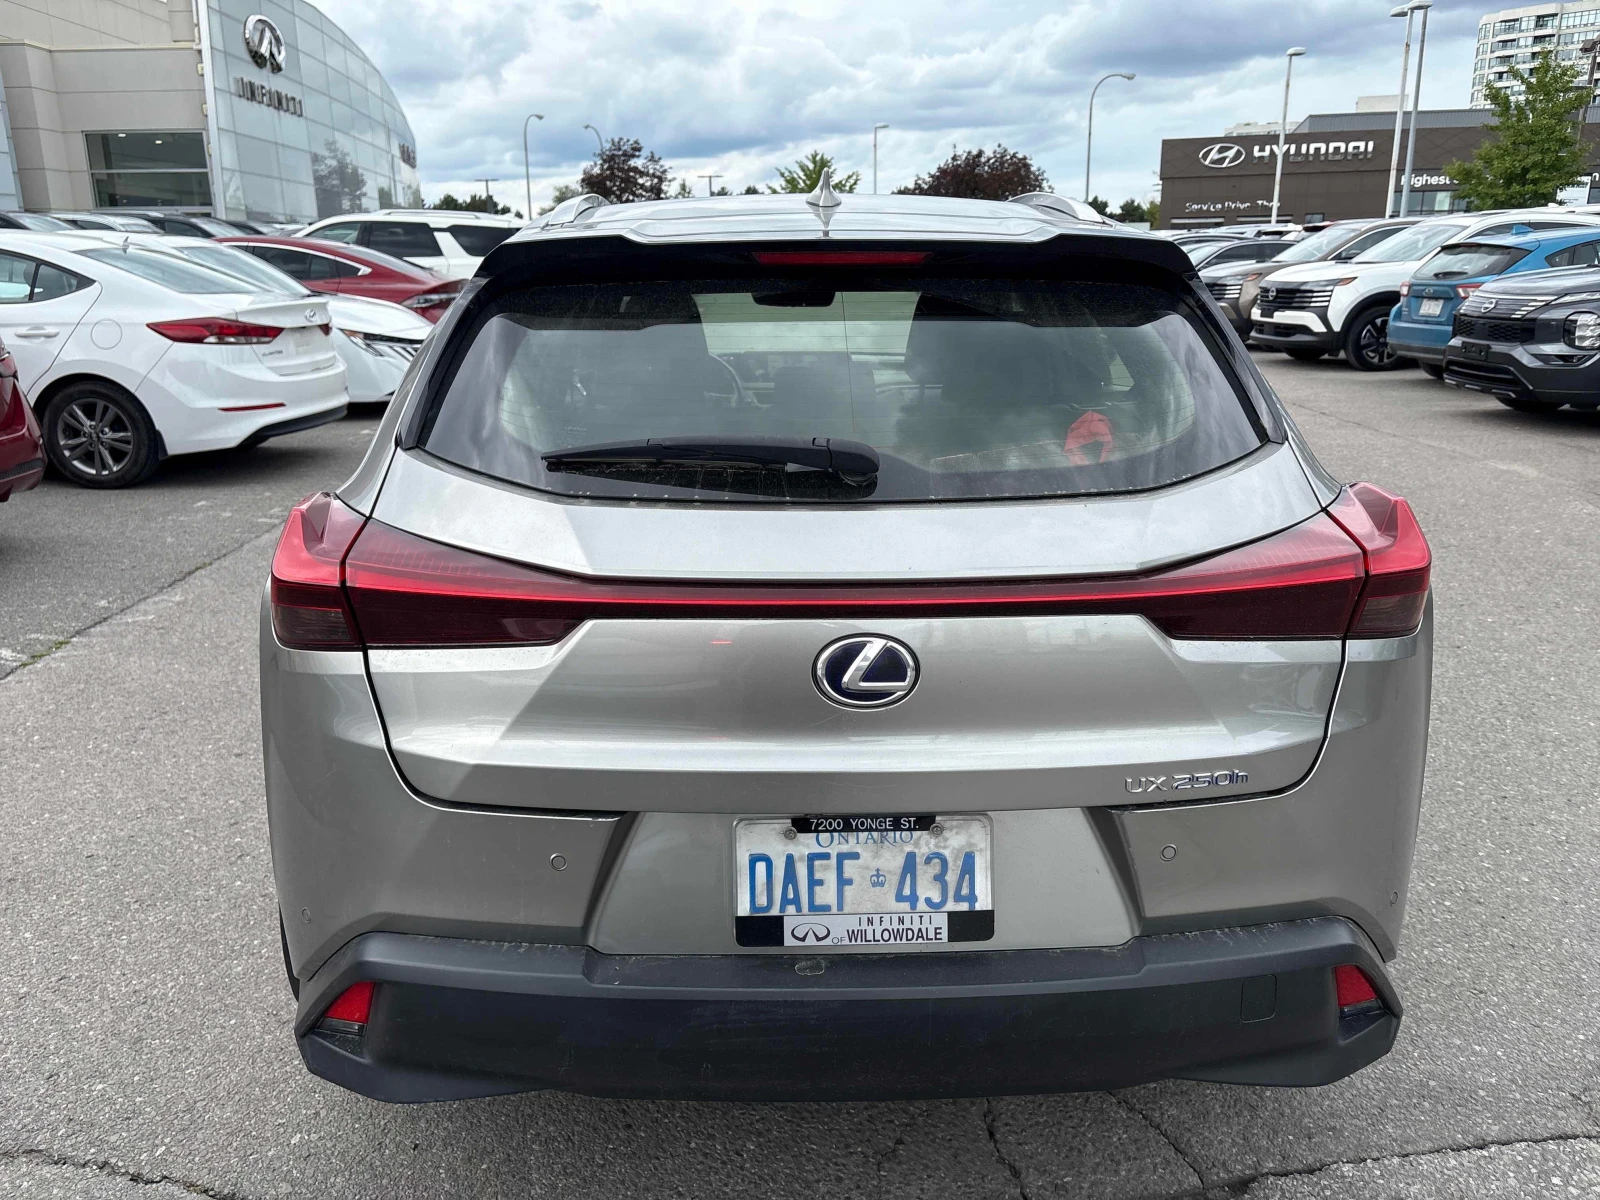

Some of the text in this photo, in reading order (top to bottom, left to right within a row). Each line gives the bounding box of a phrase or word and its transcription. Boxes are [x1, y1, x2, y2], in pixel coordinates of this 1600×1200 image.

[1253, 141, 1375, 163] HYUNDAI
[1185, 202, 1222, 213] Service
[1125, 768, 1249, 793] UX 250h
[810, 817, 919, 831] 7200 YONGE ST.
[815, 830, 914, 848] ONTARIO
[748, 851, 979, 914] DAEF 434
[858, 914, 933, 927] INFINITI
[831, 926, 943, 945] OF WILLOWDALE
